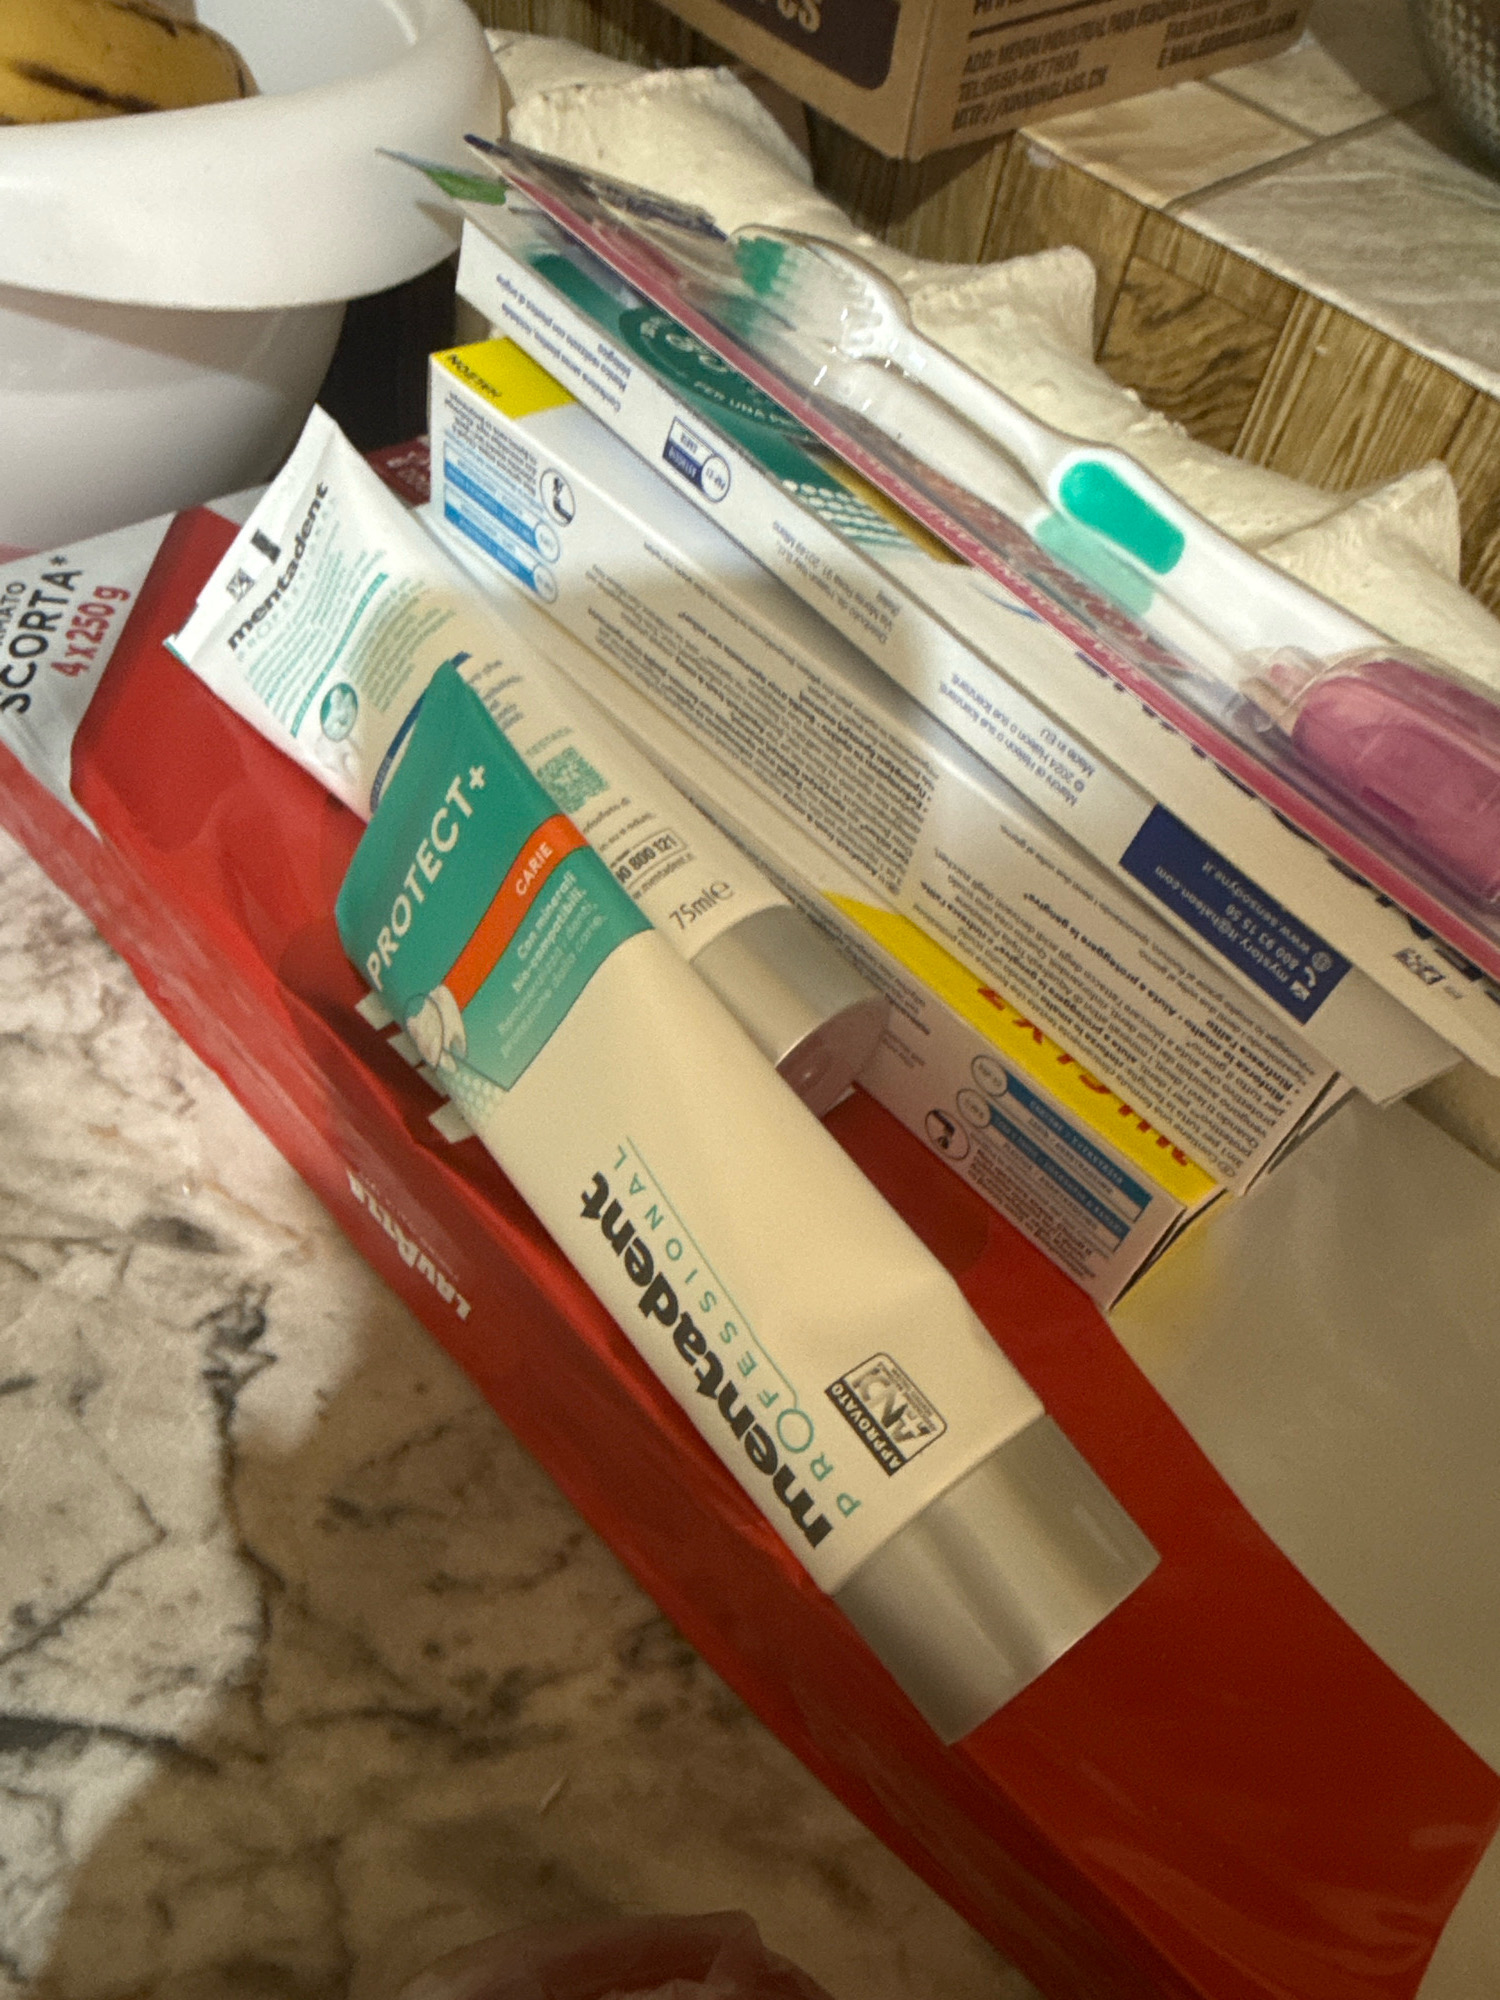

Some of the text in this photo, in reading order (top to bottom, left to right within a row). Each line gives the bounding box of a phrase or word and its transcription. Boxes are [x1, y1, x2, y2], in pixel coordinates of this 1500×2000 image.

[225, 481, 330, 651] mentadent
[366, 764, 485, 986] PROTECT+
[510, 839, 556, 898] CARIE
[514, 928, 540, 961] Con
[531, 868, 579, 932] minerali
[581, 1171, 832, 1548] mentadent
[615, 1146, 863, 1517] PROFESSIONAL
[830, 1381, 902, 1470] APPROVATO
